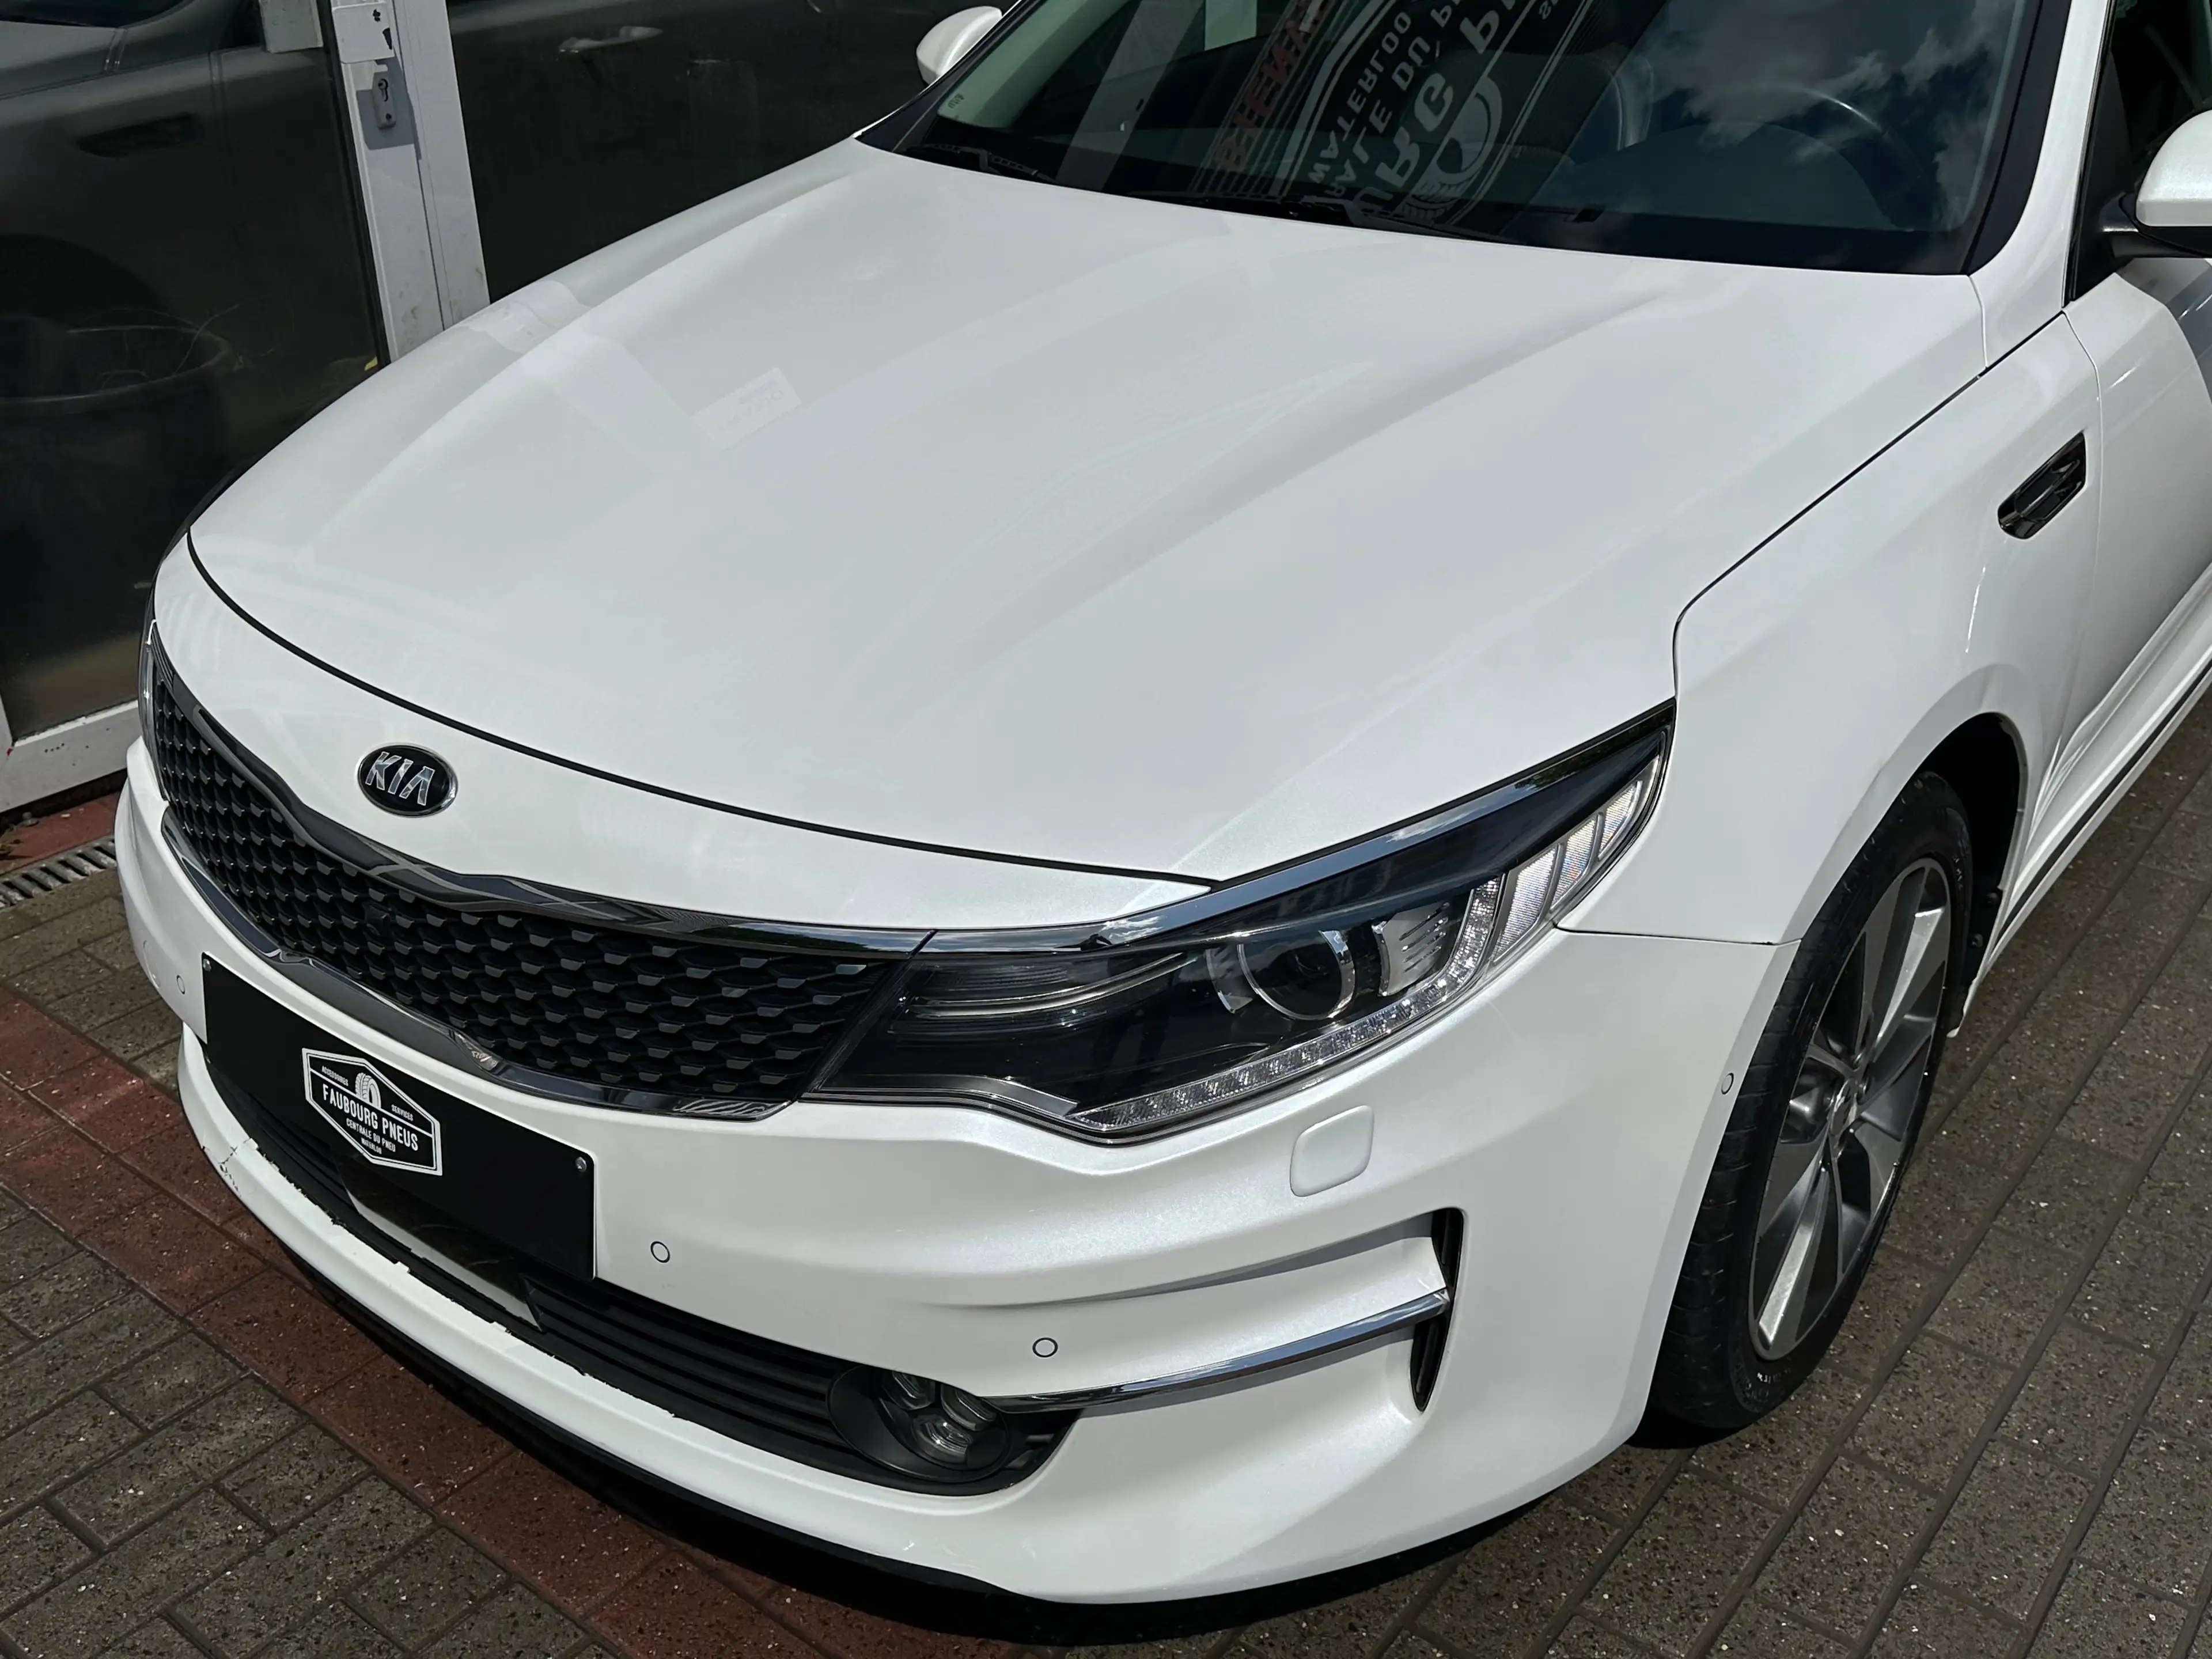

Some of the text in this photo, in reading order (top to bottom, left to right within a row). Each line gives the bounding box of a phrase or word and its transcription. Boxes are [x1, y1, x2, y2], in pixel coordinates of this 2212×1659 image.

[365, 751, 435, 806] KIA
[323, 1084, 418, 1151] FAUBOURG PNEUS
[391, 1104, 414, 1122] SERVICES
[346, 1118, 396, 1152] CENTRALE DU PNEU
[361, 1137, 382, 1154] WATERLOO
